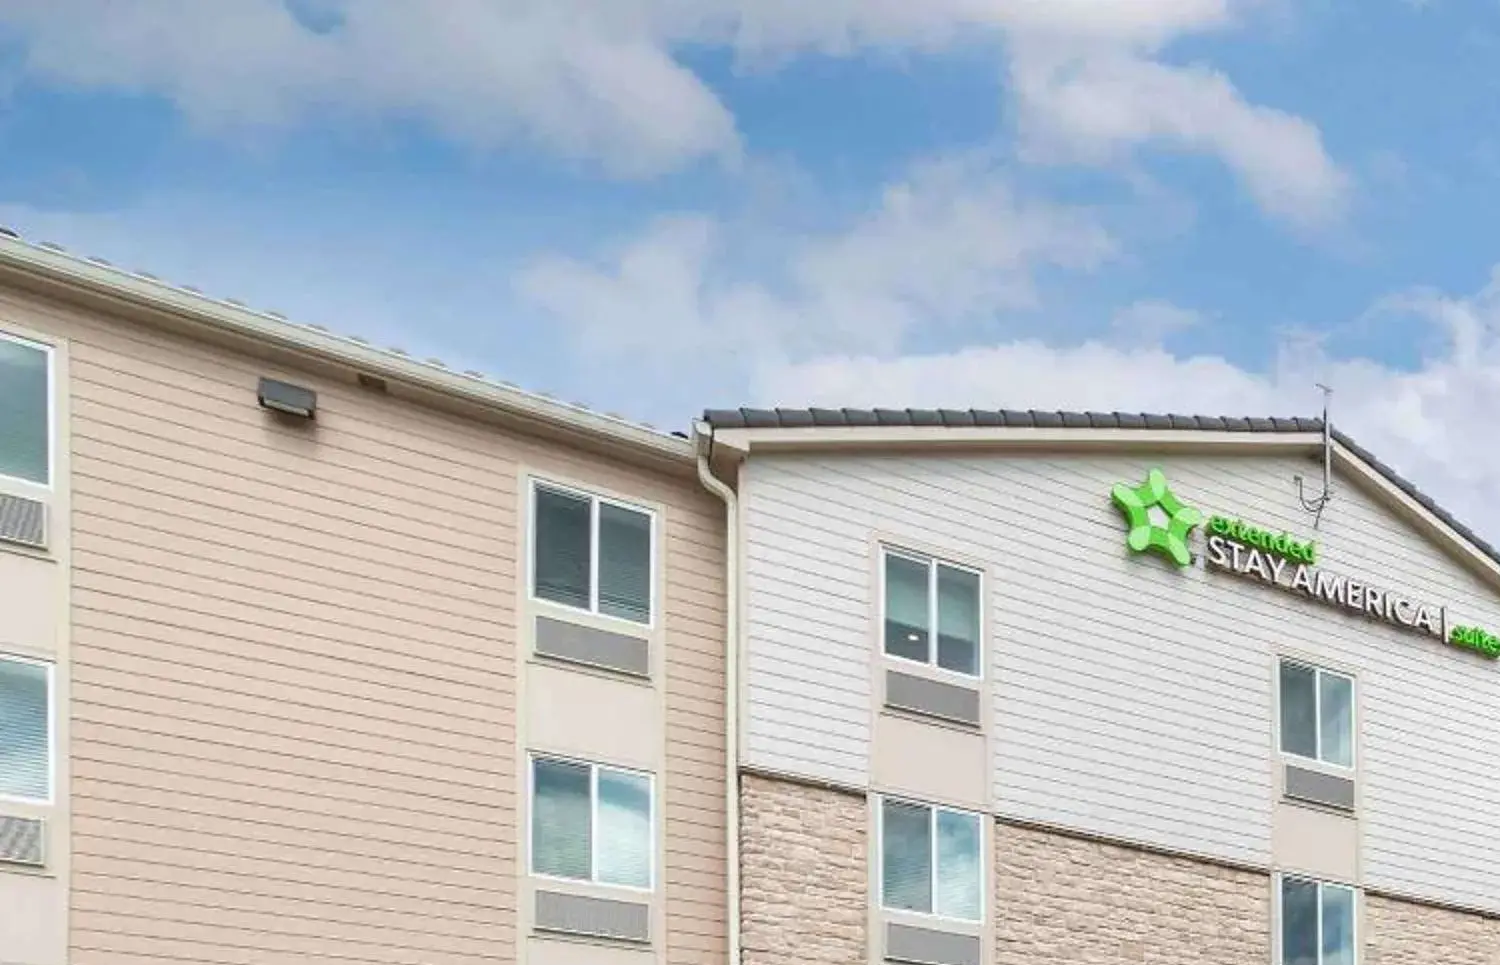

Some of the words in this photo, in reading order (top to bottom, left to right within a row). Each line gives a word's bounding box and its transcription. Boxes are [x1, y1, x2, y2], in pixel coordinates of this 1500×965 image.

[1209, 515, 1316, 563] extended
[1208, 535, 1287, 583] STAY
[1292, 564, 1433, 631] AMERICA
